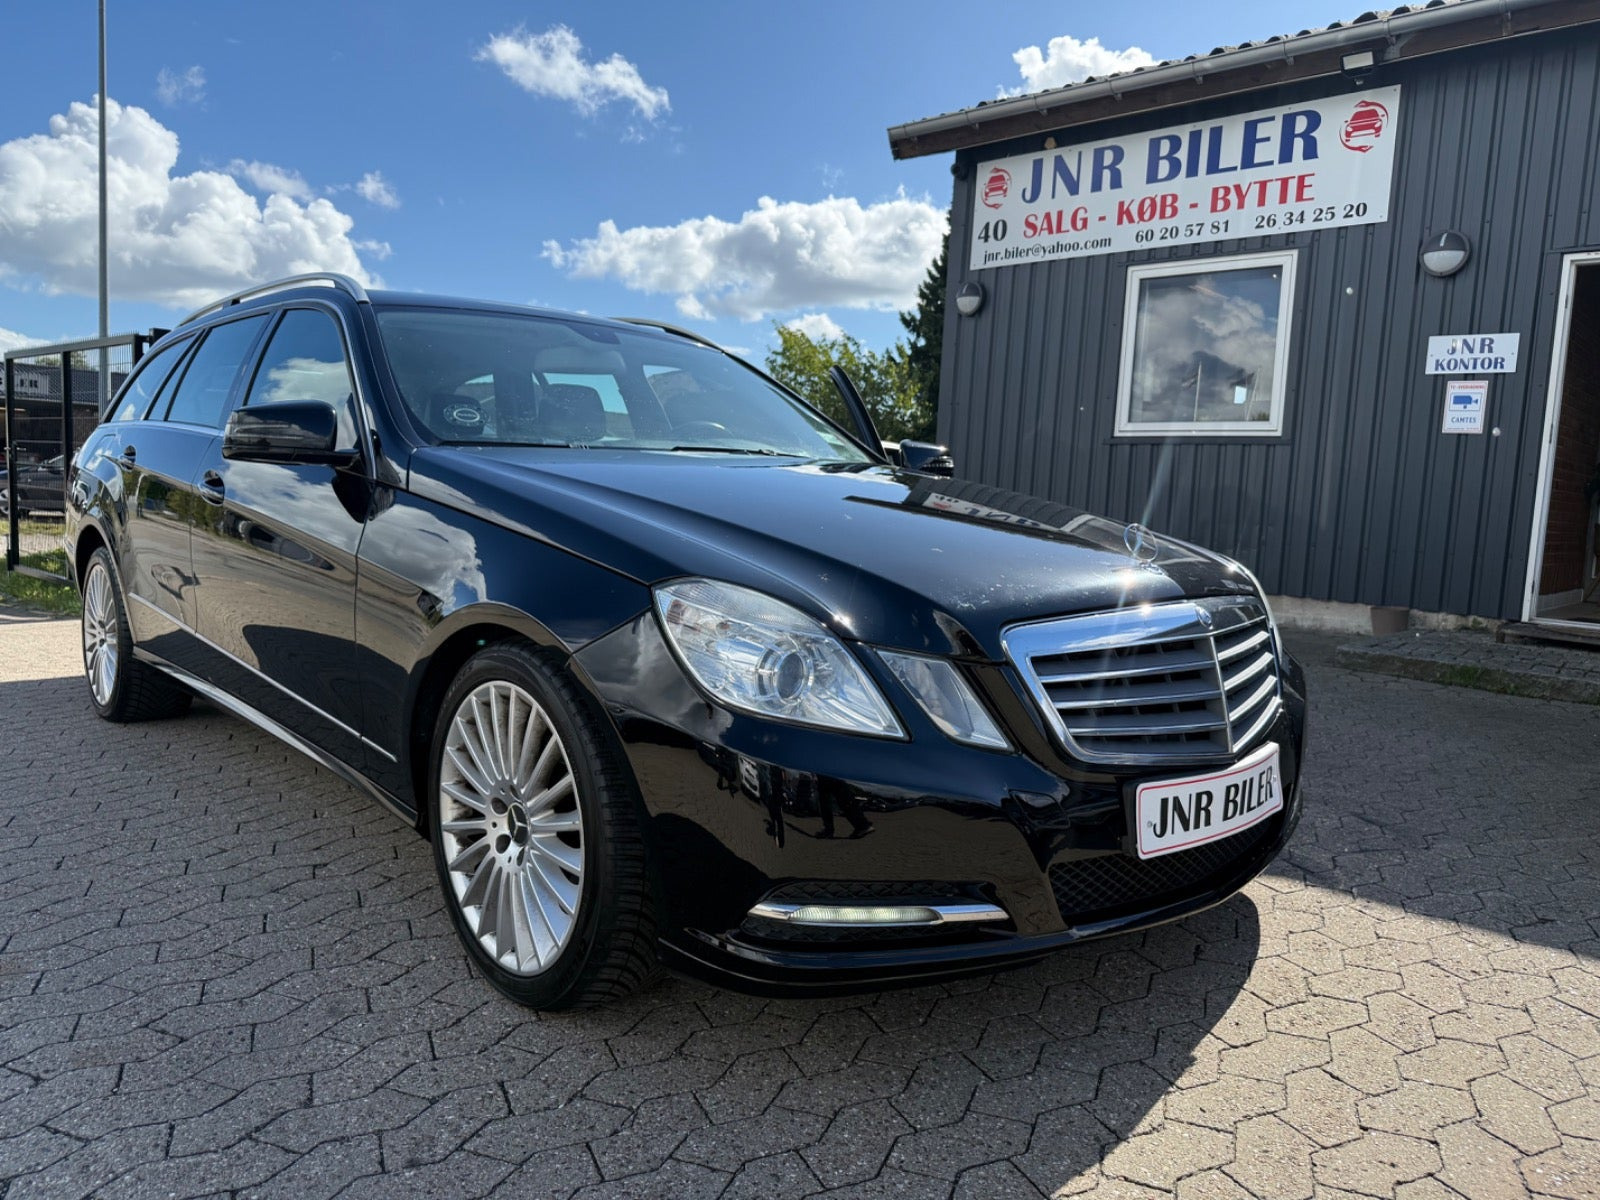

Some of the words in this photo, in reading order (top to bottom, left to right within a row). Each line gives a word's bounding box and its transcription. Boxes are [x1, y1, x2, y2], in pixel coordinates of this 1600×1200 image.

[1022, 147, 1125, 204] JNR
[1146, 109, 1322, 185] BILER
[1024, 207, 1089, 239] SALG
[1116, 193, 1179, 226] KØB
[1210, 173, 1315, 213] BYTTE
[1254, 213, 1277, 229] 26
[1283, 211, 1305, 226] 34
[1313, 207, 1336, 223] 25
[1343, 202, 1368, 218] 20
[978, 219, 1008, 244] 40
[1135, 229, 1155, 243] 60
[1160, 226, 1180, 241] 20
[1184, 223, 1205, 238] 57
[1210, 219, 1230, 234] 81
[983, 237, 1112, 265] jnr.biler@yahoo.com
[1447, 337, 1495, 355] JNR
[1434, 357, 1505, 371] KONTOR
[1152, 790, 1214, 838] JNR
[1222, 765, 1274, 822] BILER
